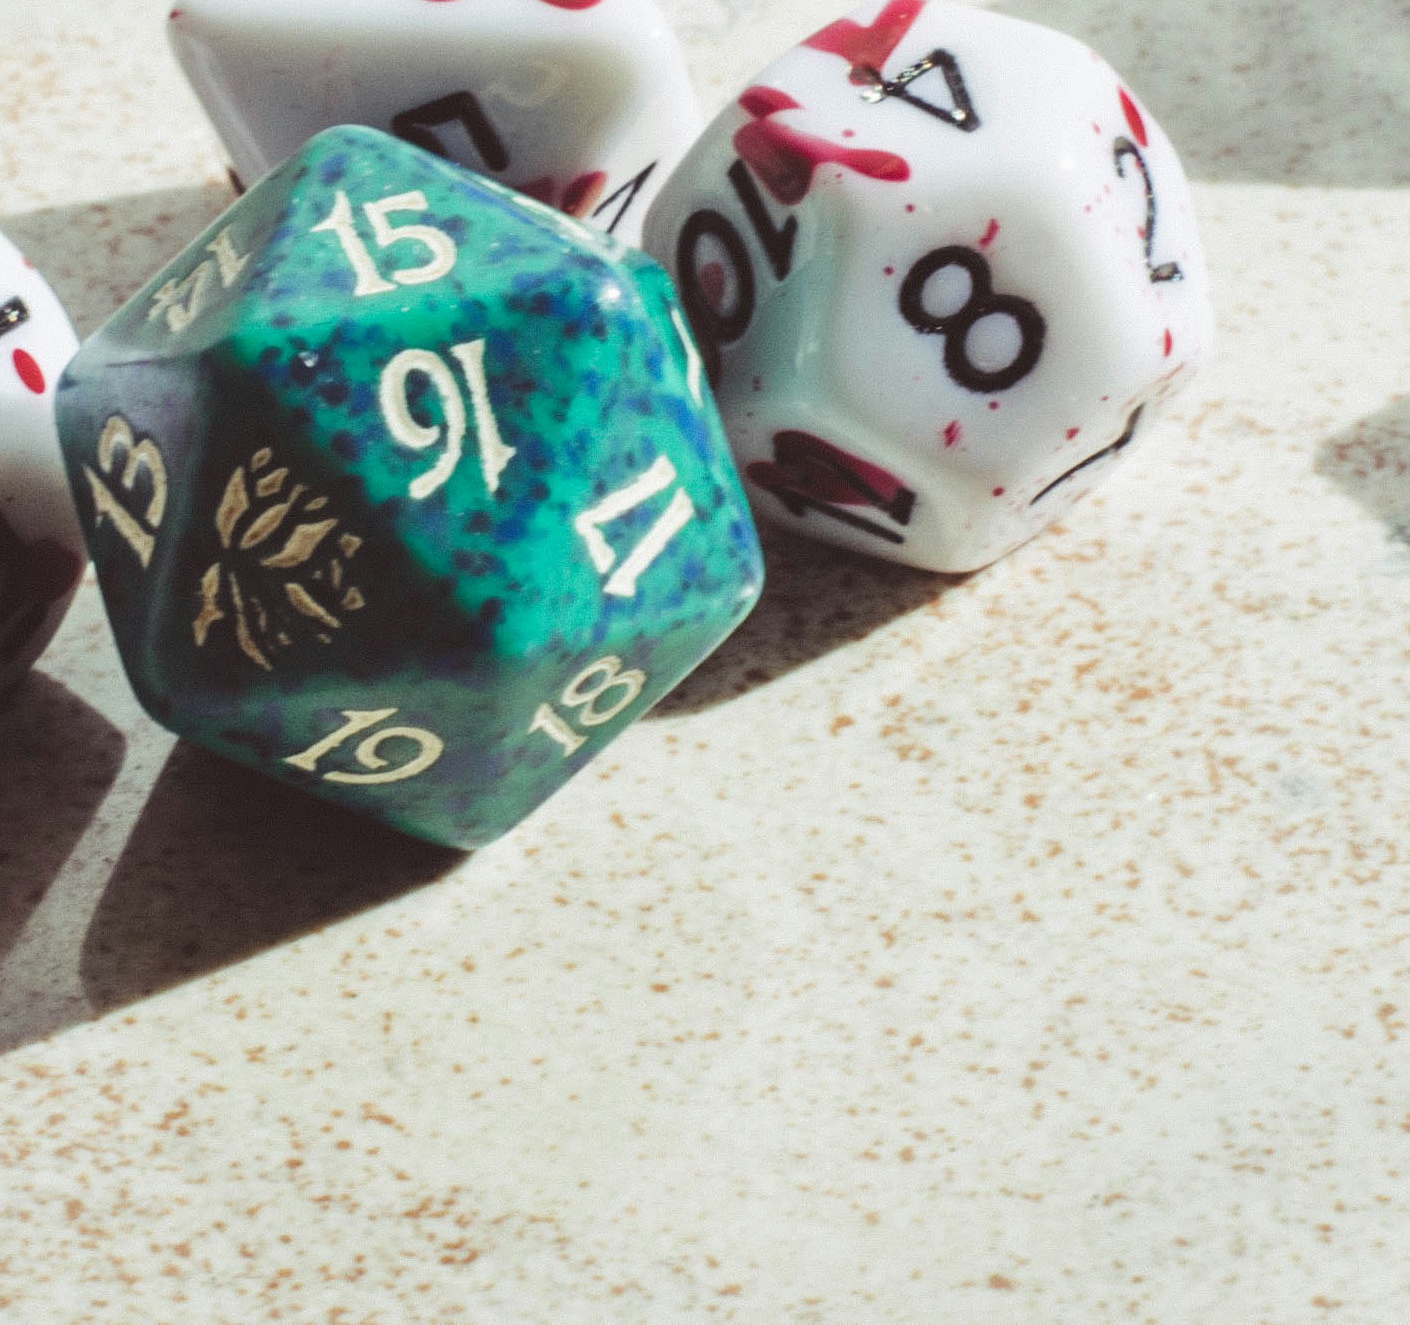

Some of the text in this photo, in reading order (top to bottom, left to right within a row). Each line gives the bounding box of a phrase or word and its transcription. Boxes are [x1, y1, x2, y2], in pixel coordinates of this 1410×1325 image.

[853, 48, 981, 133] 4
[148, 224, 253, 332] 14
[312, 190, 457, 298] 15
[675, 159, 798, 354] 10
[898, 244, 1046, 393] 8
[380, 338, 517, 499] 16
[85, 416, 167, 568] 13
[575, 456, 694, 598] 17
[284, 708, 444, 785] 19
[530, 655, 647, 759] 18
